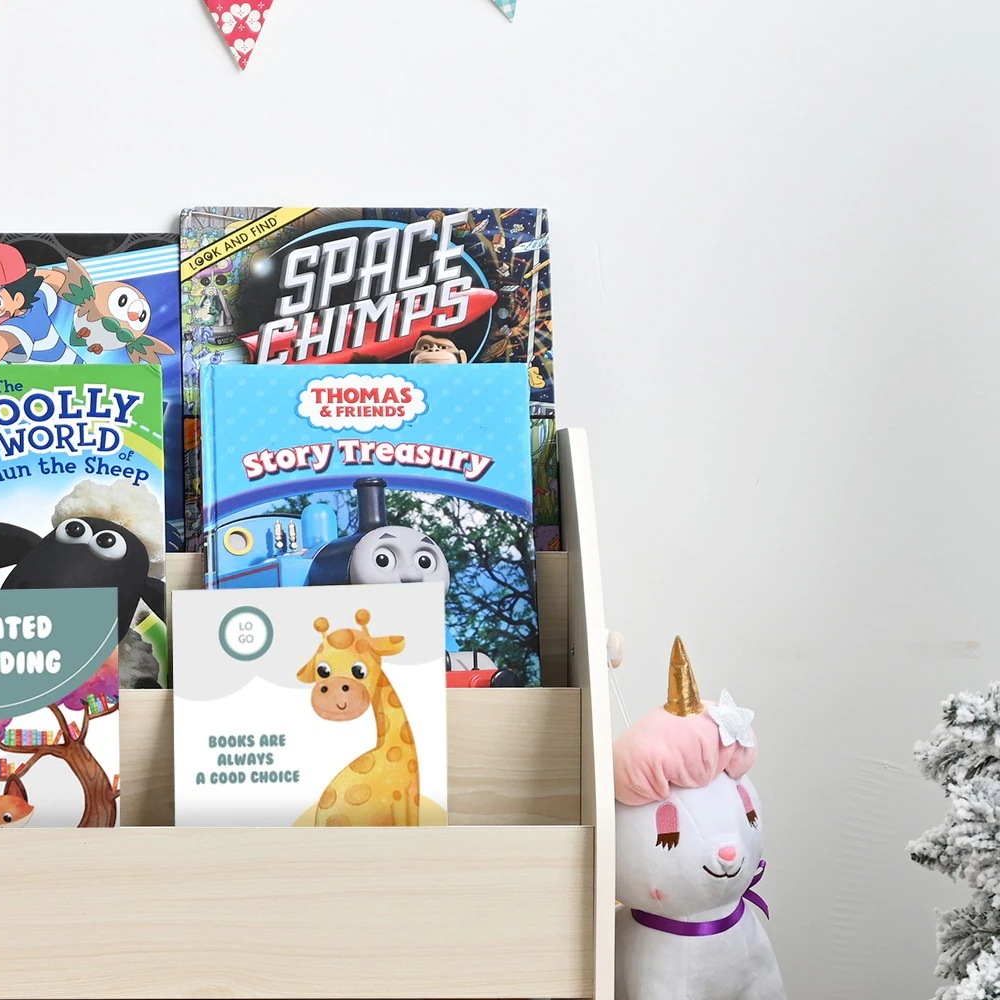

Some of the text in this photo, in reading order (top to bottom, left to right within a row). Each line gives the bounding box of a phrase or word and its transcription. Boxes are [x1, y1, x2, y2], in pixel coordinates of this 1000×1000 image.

[189, 217, 278, 270] LOOK AND FIND
[279, 211, 469, 317] SPACE
[256, 276, 473, 364] CHIMPS
[311, 387, 412, 404] THOMAS
[320, 406, 406, 418] & FRIENDS
[118, 450, 134, 462] of
[242, 439, 494, 481] Story Treasury
[38, 457, 76, 476] the
[85, 457, 150, 486] Sheep
[238, 622, 253, 632] LO
[238, 634, 254, 644] GO
[208, 734, 286, 748] BOOKS ARE
[217, 752, 274, 766] ALWAYS
[196, 770, 300, 784] A GOOD CHOICE
